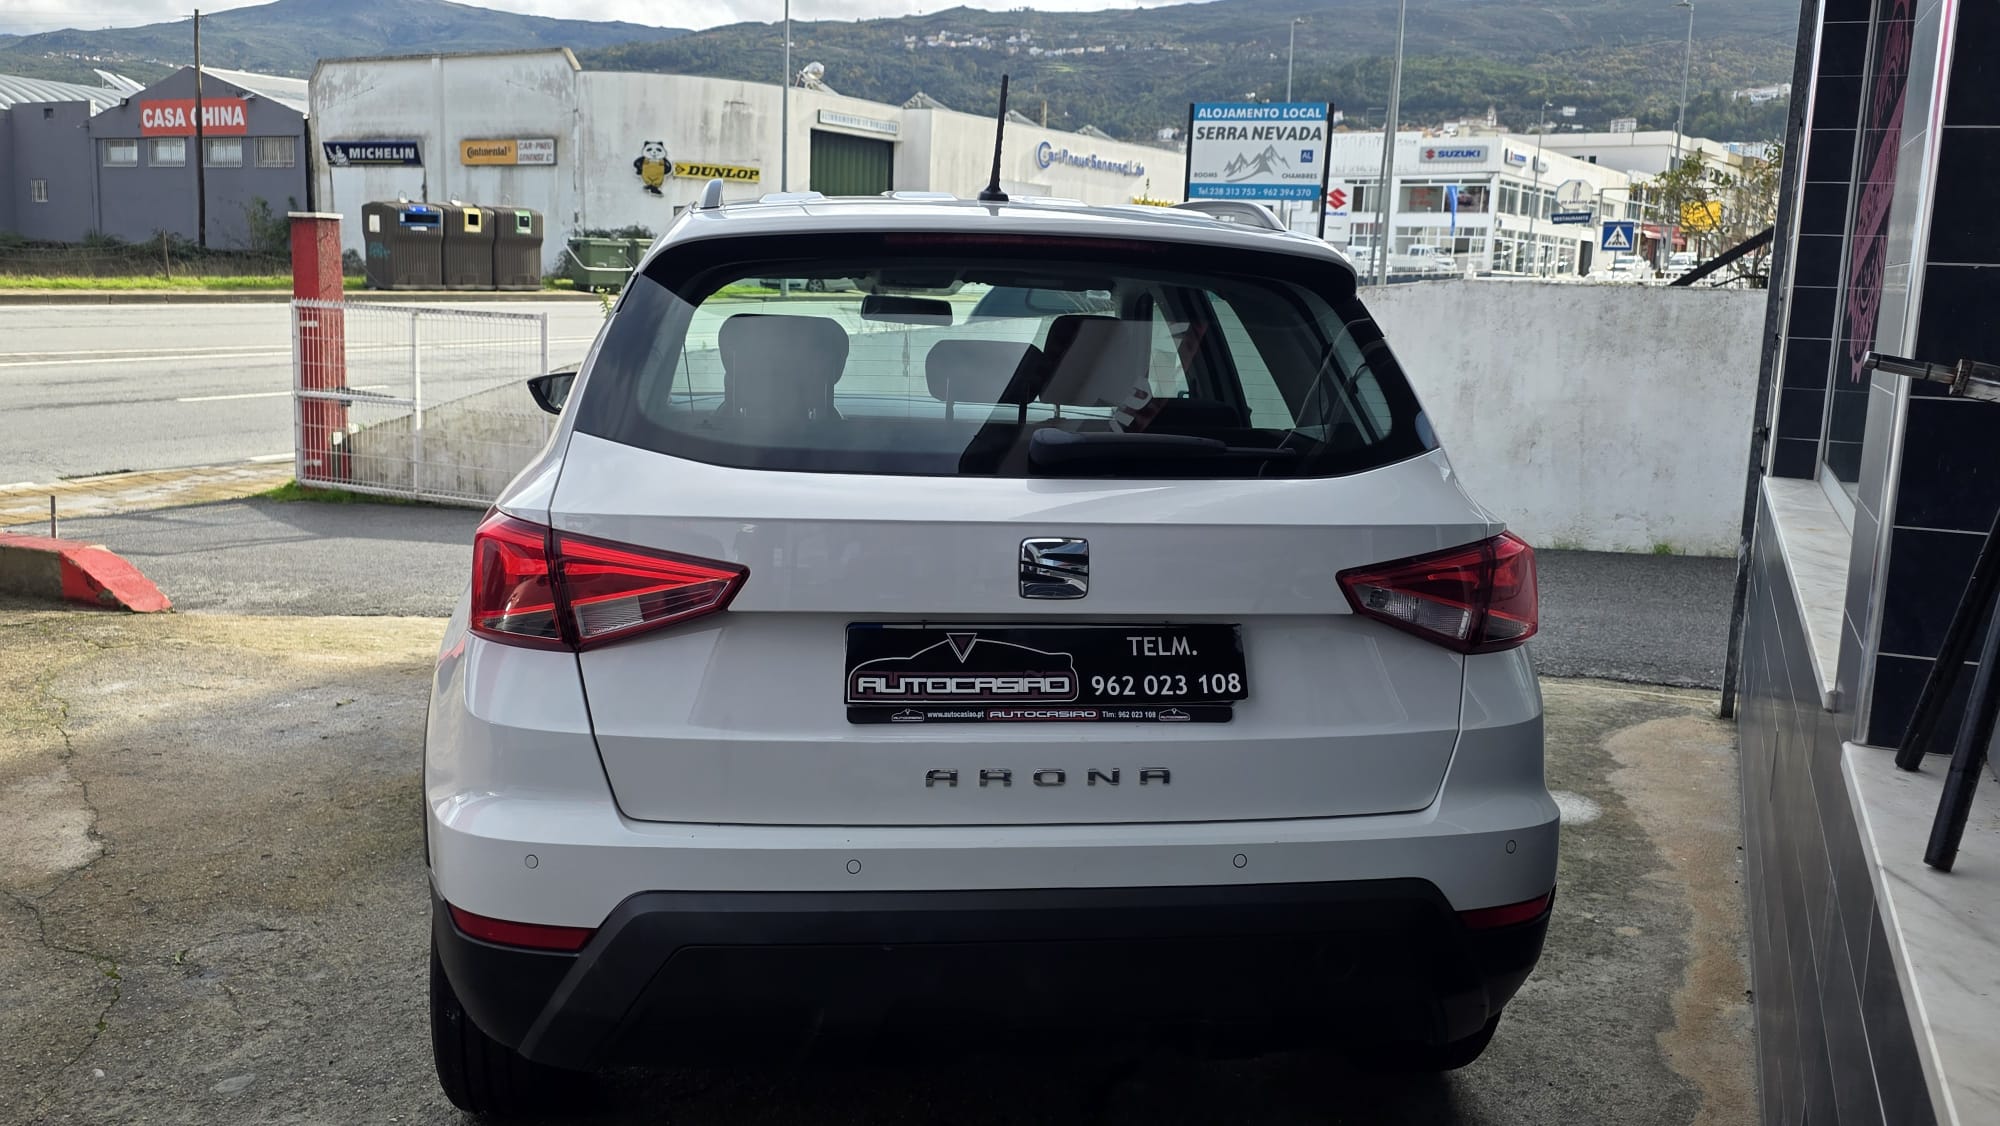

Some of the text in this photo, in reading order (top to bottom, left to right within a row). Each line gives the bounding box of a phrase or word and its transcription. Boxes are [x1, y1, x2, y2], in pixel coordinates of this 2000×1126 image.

[142, 105, 246, 128] CASA CHINA
[1198, 107, 1322, 119] ALOJAMENTO LOCAL
[1196, 126, 1323, 141] SERRA NEVADA
[348, 147, 415, 159] MICHELIN
[466, 146, 508, 159] Continental
[1438, 149, 1481, 158] SUZUKI
[687, 165, 760, 180] DUNLOP
[1281, 172, 1318, 180] CHAMBRES
[1225, 187, 1240, 196] 313
[1241, 188, 1256, 196] 753
[1263, 188, 1279, 197] 962
[1280, 188, 1295, 197] 394
[1295, 189, 1312, 197] 370
[1126, 636, 1198, 656] TELM.
[1091, 672, 1242, 696] 962 023 108
[927, 710, 984, 719] www.autocasiao.pt
[1118, 710, 1130, 719] 962
[1131, 710, 1143, 719] 023
[1145, 710, 1156, 718] 108
[925, 767, 1171, 788] ARONA
